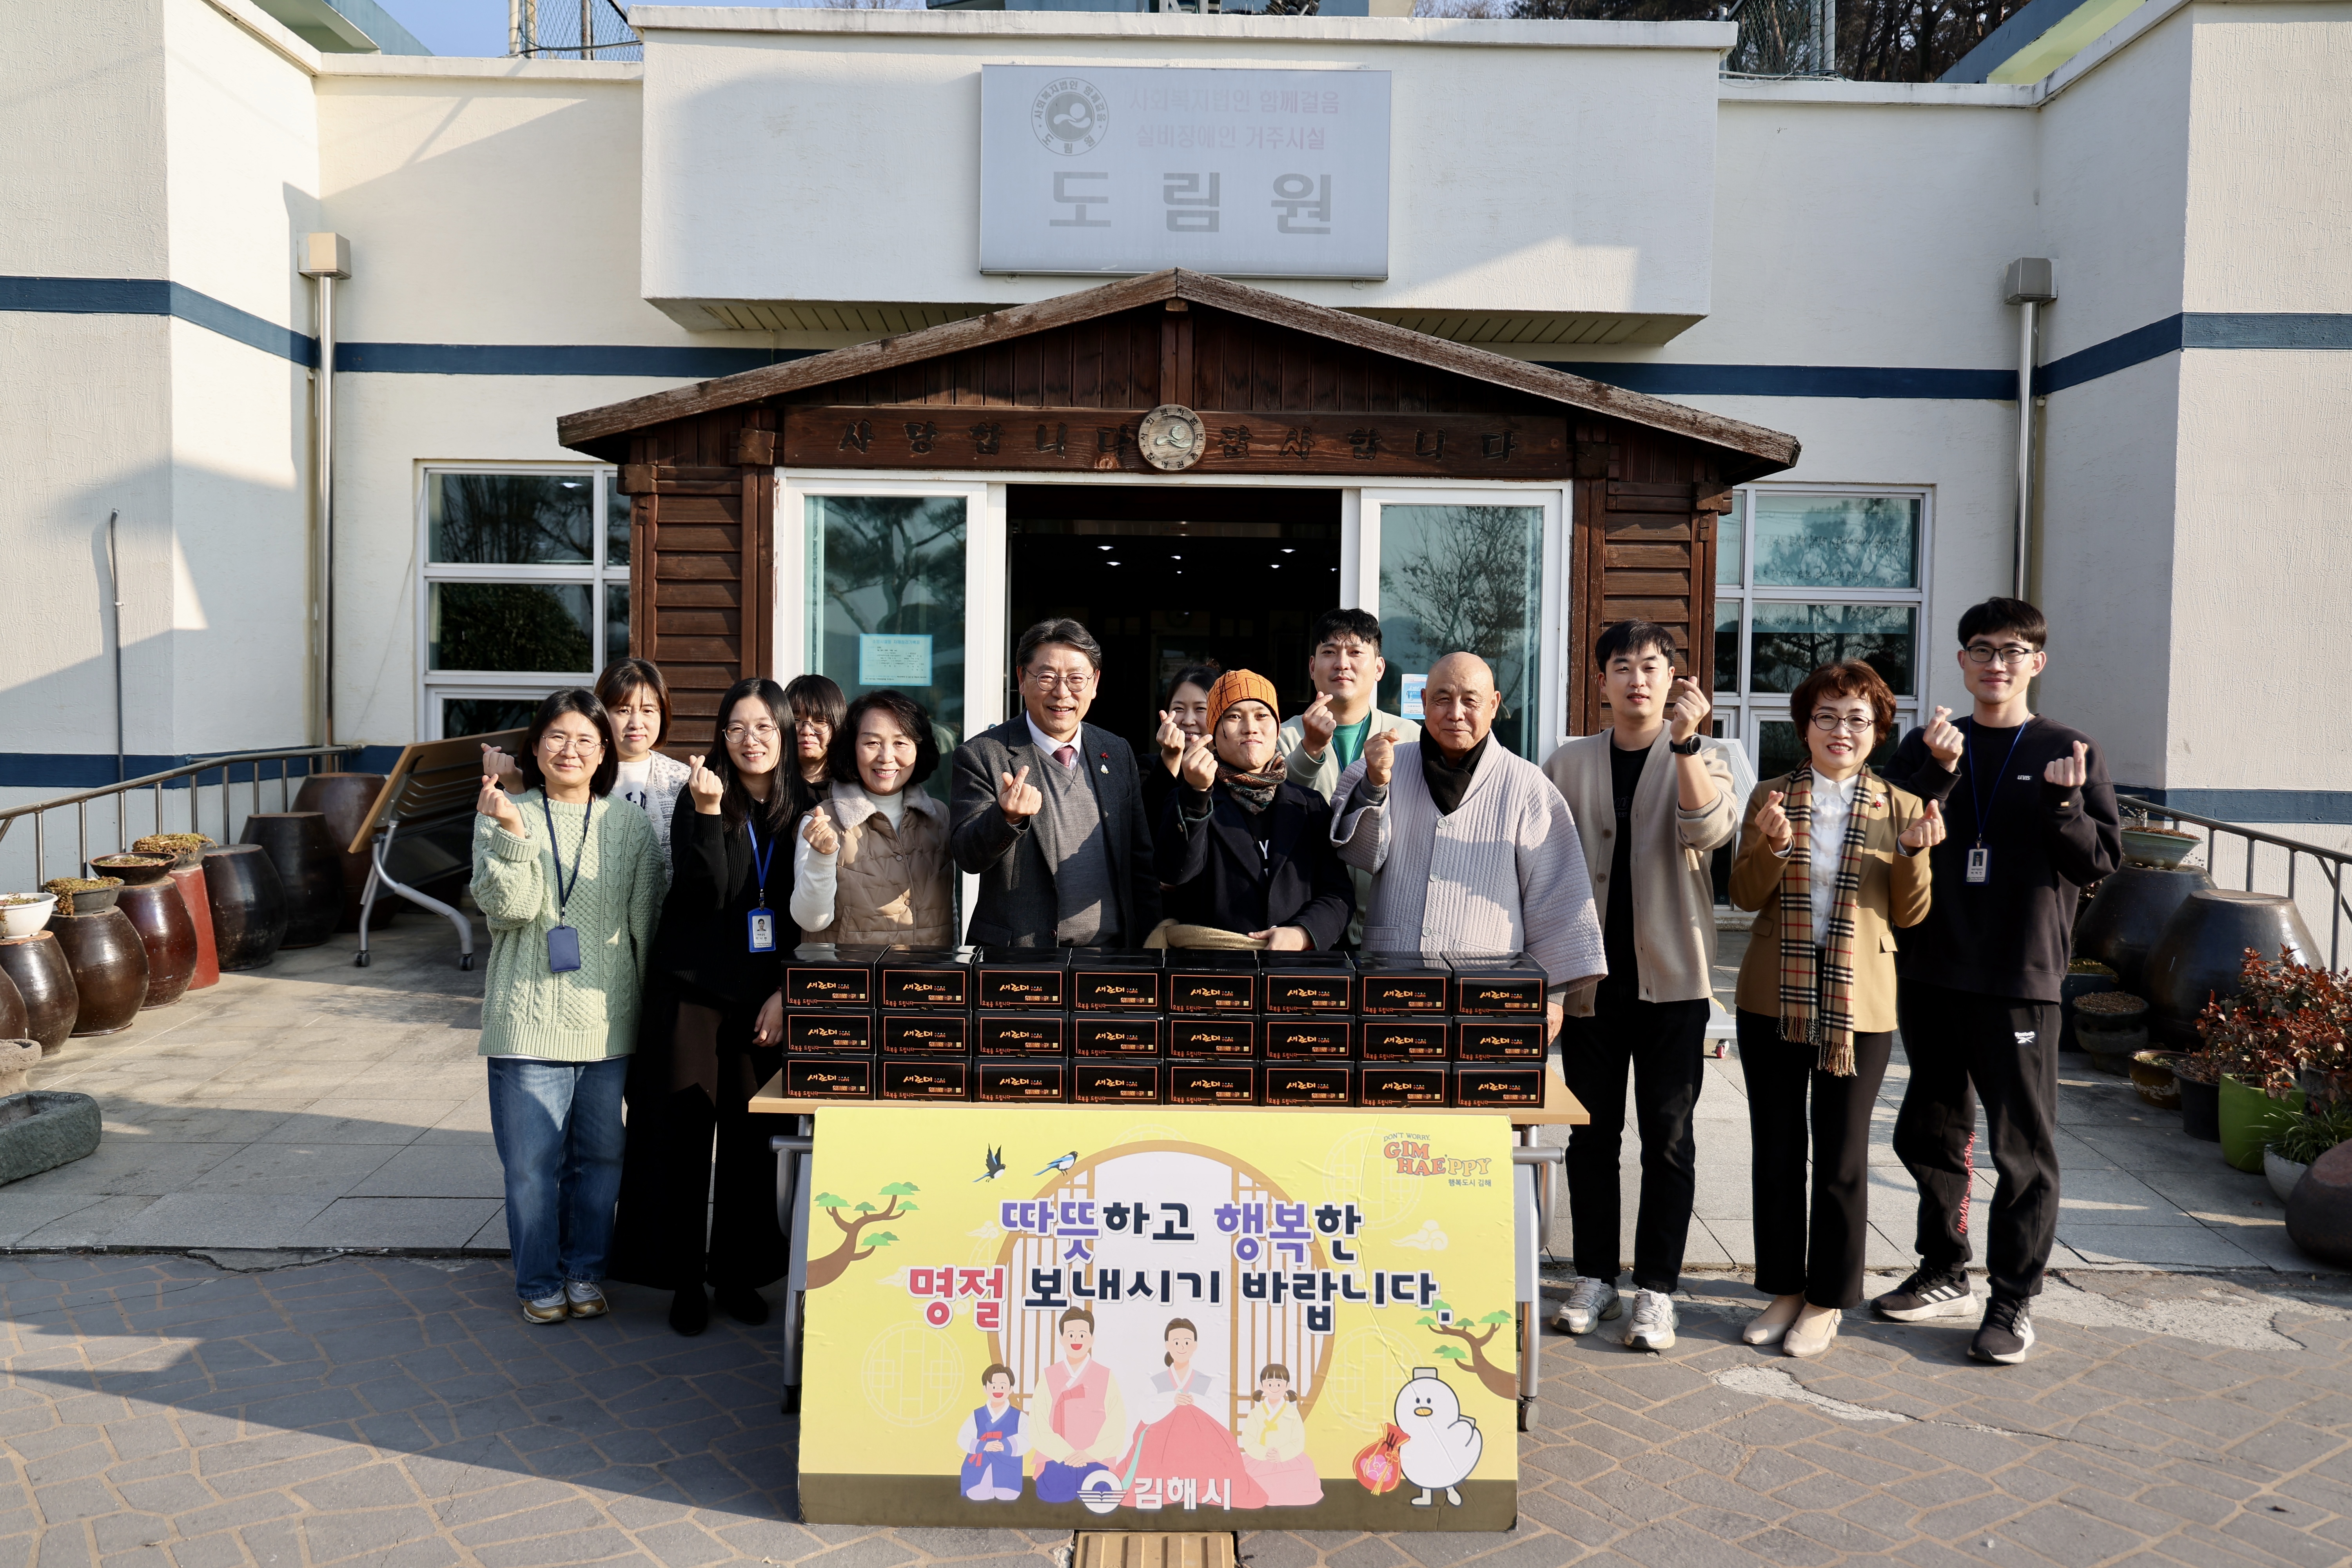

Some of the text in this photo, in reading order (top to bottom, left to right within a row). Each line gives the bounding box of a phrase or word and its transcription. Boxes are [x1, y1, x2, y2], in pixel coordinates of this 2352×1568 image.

[1034, 80, 1078, 119] 사회복지법인
[1129, 88, 1339, 114] 사회복지법인 함께걸음
[1135, 124, 1325, 151] 실비장애인 거주시설
[1049, 171, 1331, 235] 도림원
[1141, 408, 1203, 441] 사회복지법인
[1217, 425, 1516, 463] 감사합니다
[1384, 1132, 1404, 1142] DON'T
[1384, 1140, 1430, 1160] GIM
[1448, 1179, 1475, 1187] 행복도시
[1001, 1200, 1363, 1263] 따뜻하고 행복한
[1957, 1196, 1970, 1234] HUMAN
[908, 1266, 1454, 1334] 명절 보내시기 바랍니다.
[1134, 1476, 1231, 1511] 김해시
